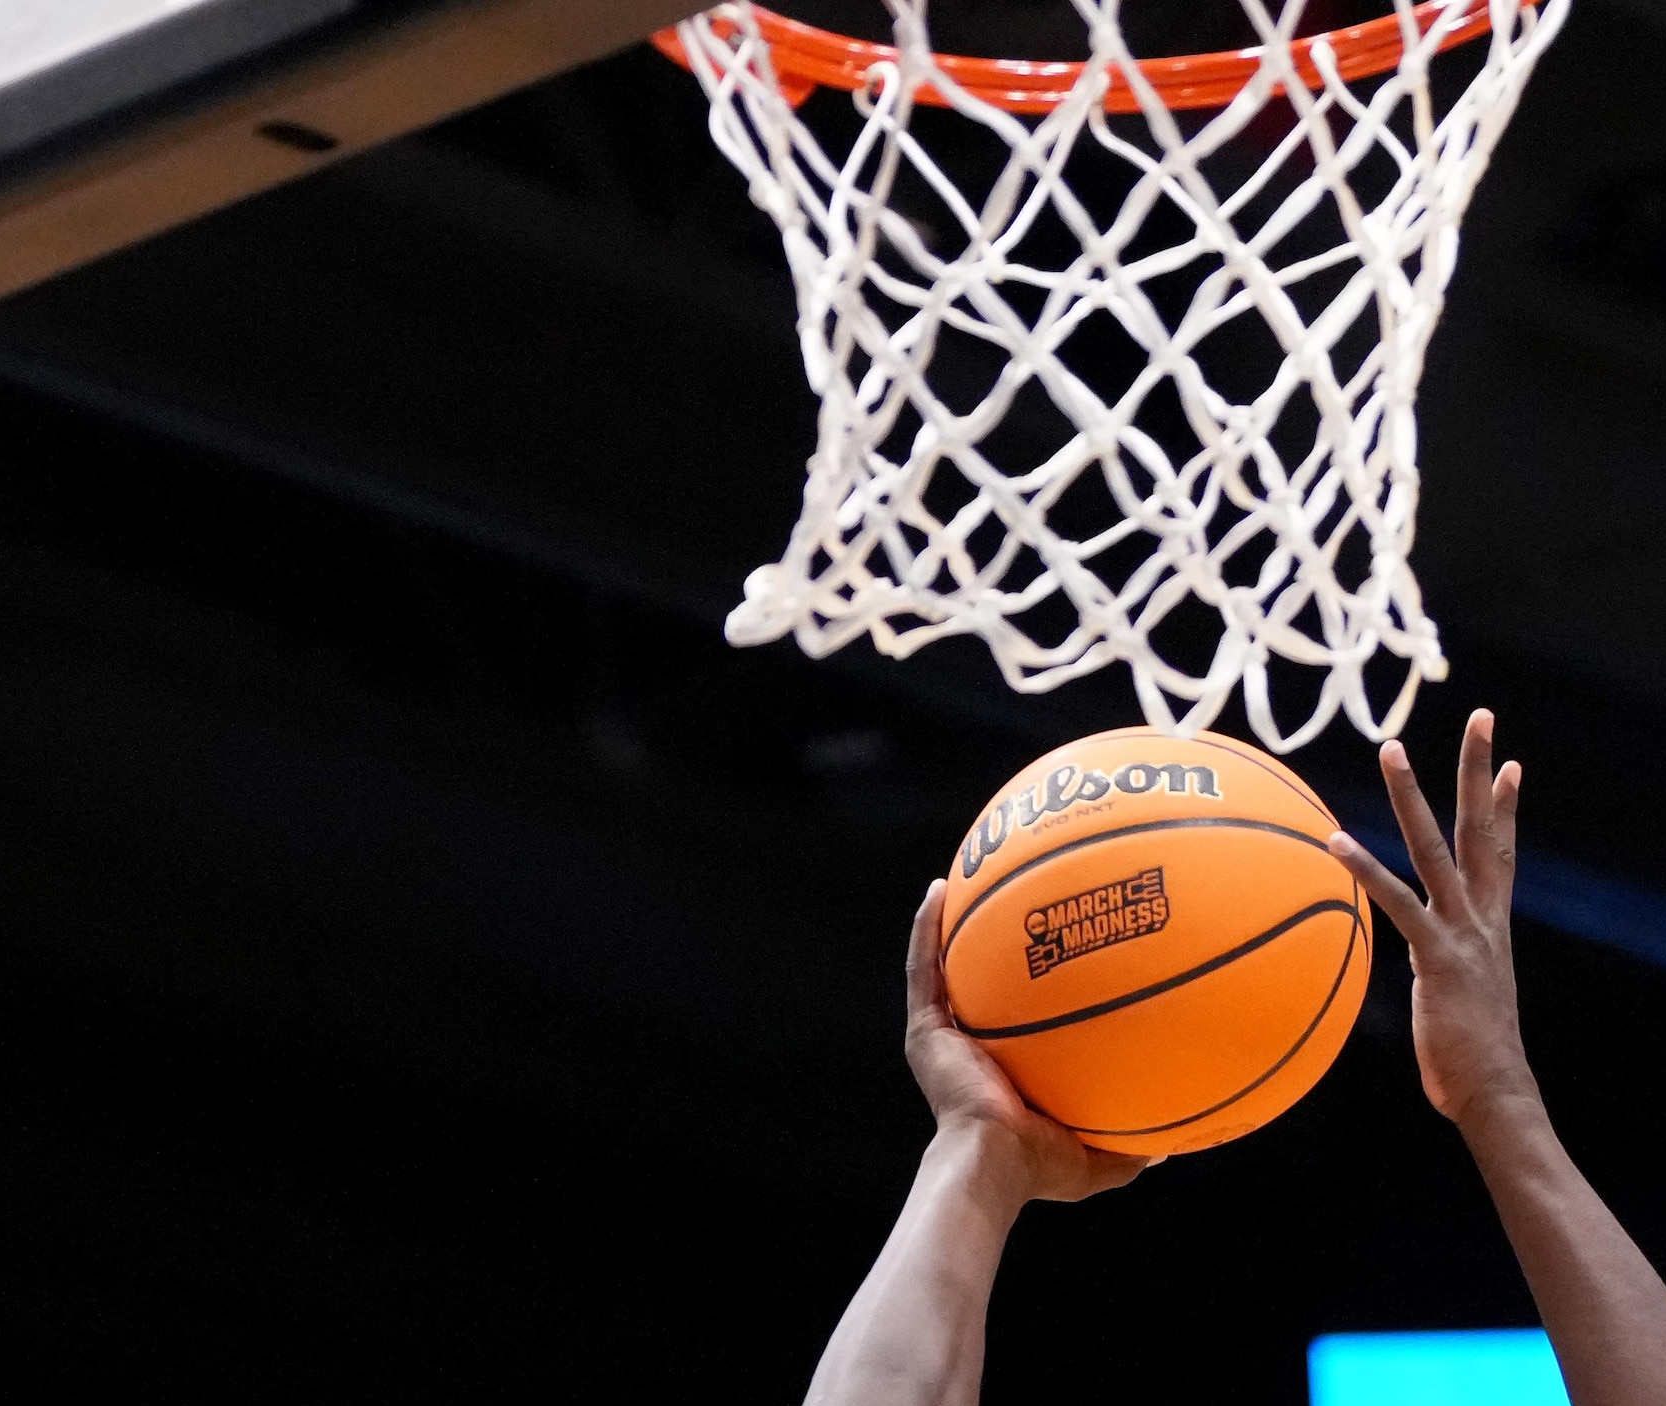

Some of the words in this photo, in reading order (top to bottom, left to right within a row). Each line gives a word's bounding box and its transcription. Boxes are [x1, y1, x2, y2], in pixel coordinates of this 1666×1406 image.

[960, 763, 1222, 880] Wilson
[1032, 814, 1069, 836] EVO
[1076, 801, 1115, 817] NXT
[1047, 884, 1123, 931] MARCH
[1061, 897, 1167, 951] MADNESS
